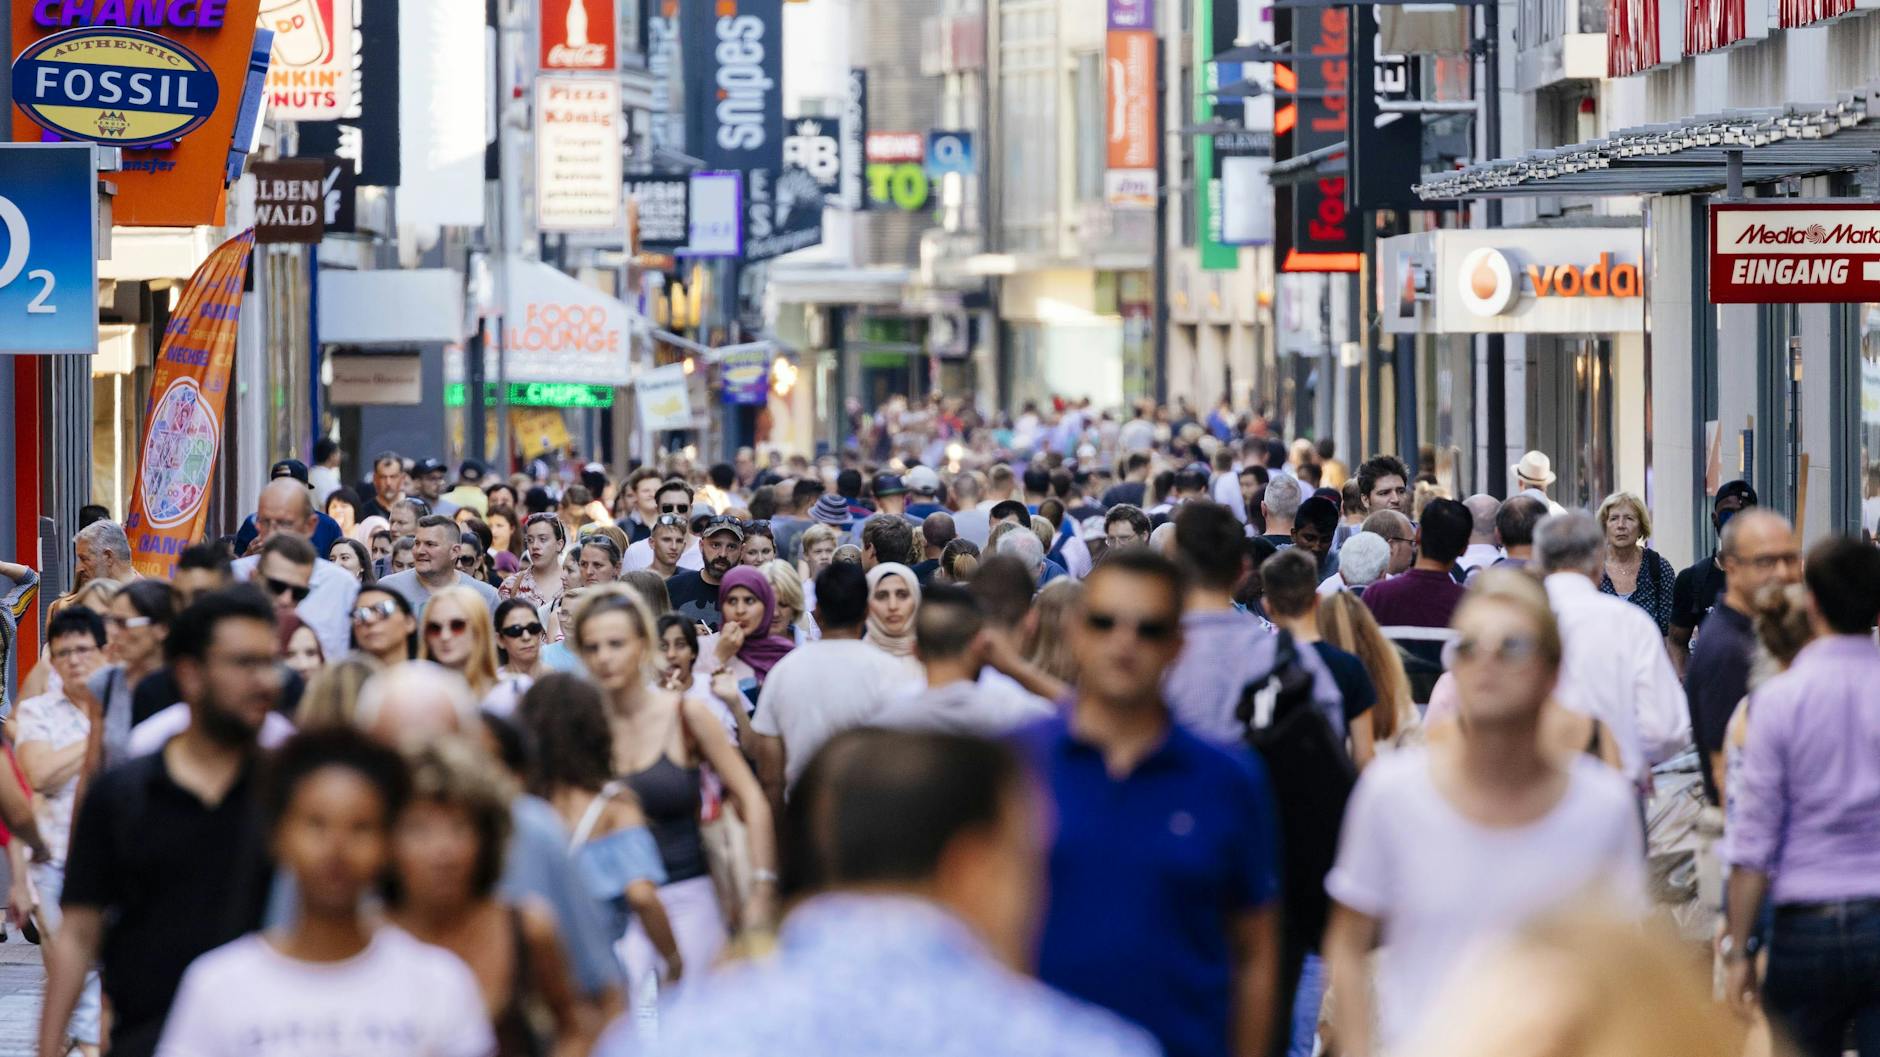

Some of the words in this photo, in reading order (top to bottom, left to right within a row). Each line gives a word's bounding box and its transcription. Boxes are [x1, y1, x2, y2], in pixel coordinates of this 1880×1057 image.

[32, 0, 228, 28] CHANGE
[53, 39, 182, 67] AUTHENTIC
[716, 15, 774, 150] snipes
[1311, 7, 1348, 132] Locke
[35, 66, 199, 109] FOSSIL
[267, 91, 337, 108] NUTS
[866, 164, 928, 210] TO
[1309, 150, 1348, 242] Foo
[255, 204, 316, 226] WALD
[1735, 223, 1807, 244] Media
[1822, 223, 1880, 244] Mark
[1731, 258, 1850, 285] EINGANG
[526, 303, 607, 325] FOOD
[511, 327, 619, 352] LOUNGE
